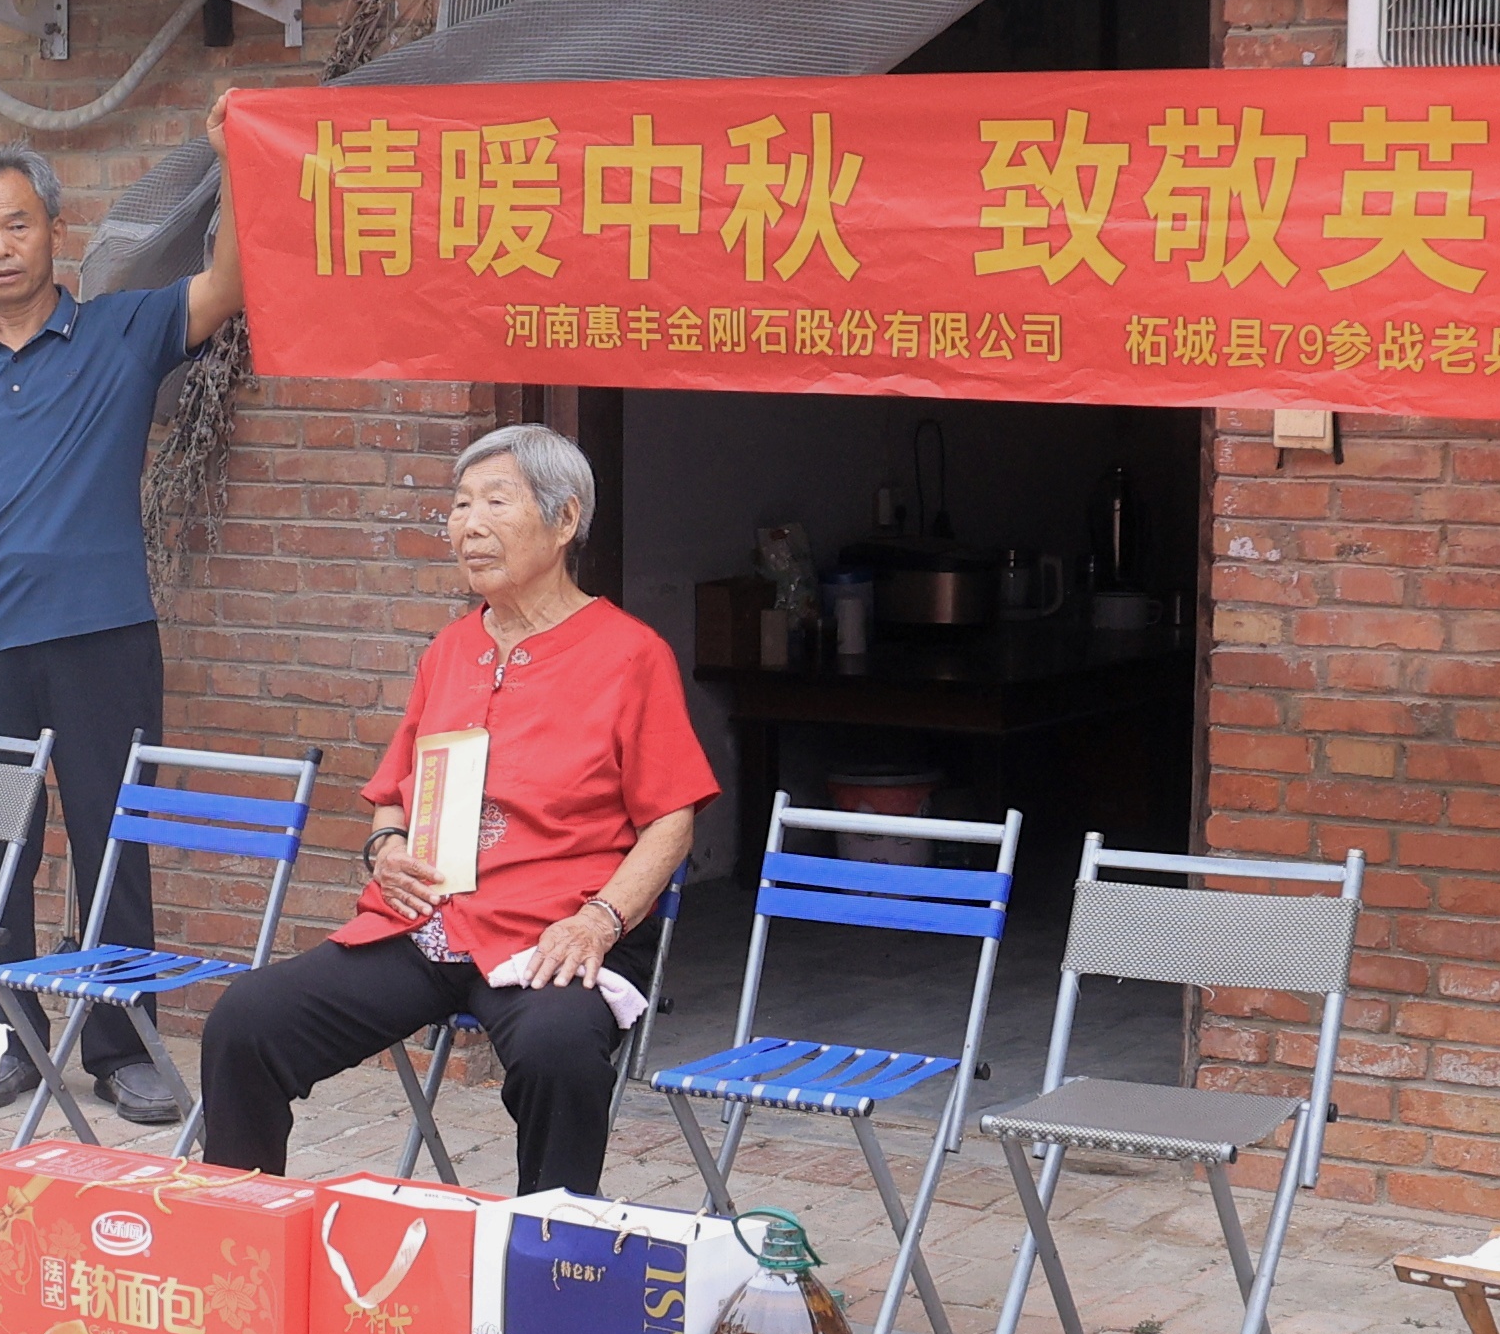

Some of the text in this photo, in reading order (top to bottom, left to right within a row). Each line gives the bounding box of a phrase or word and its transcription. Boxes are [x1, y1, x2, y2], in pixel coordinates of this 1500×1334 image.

[300, 113, 864, 281] 情暖中秋
[504, 303, 1062, 363] 河南惠丰金刚石股份有限公司
[43, 1260, 65, 1307] 法式
